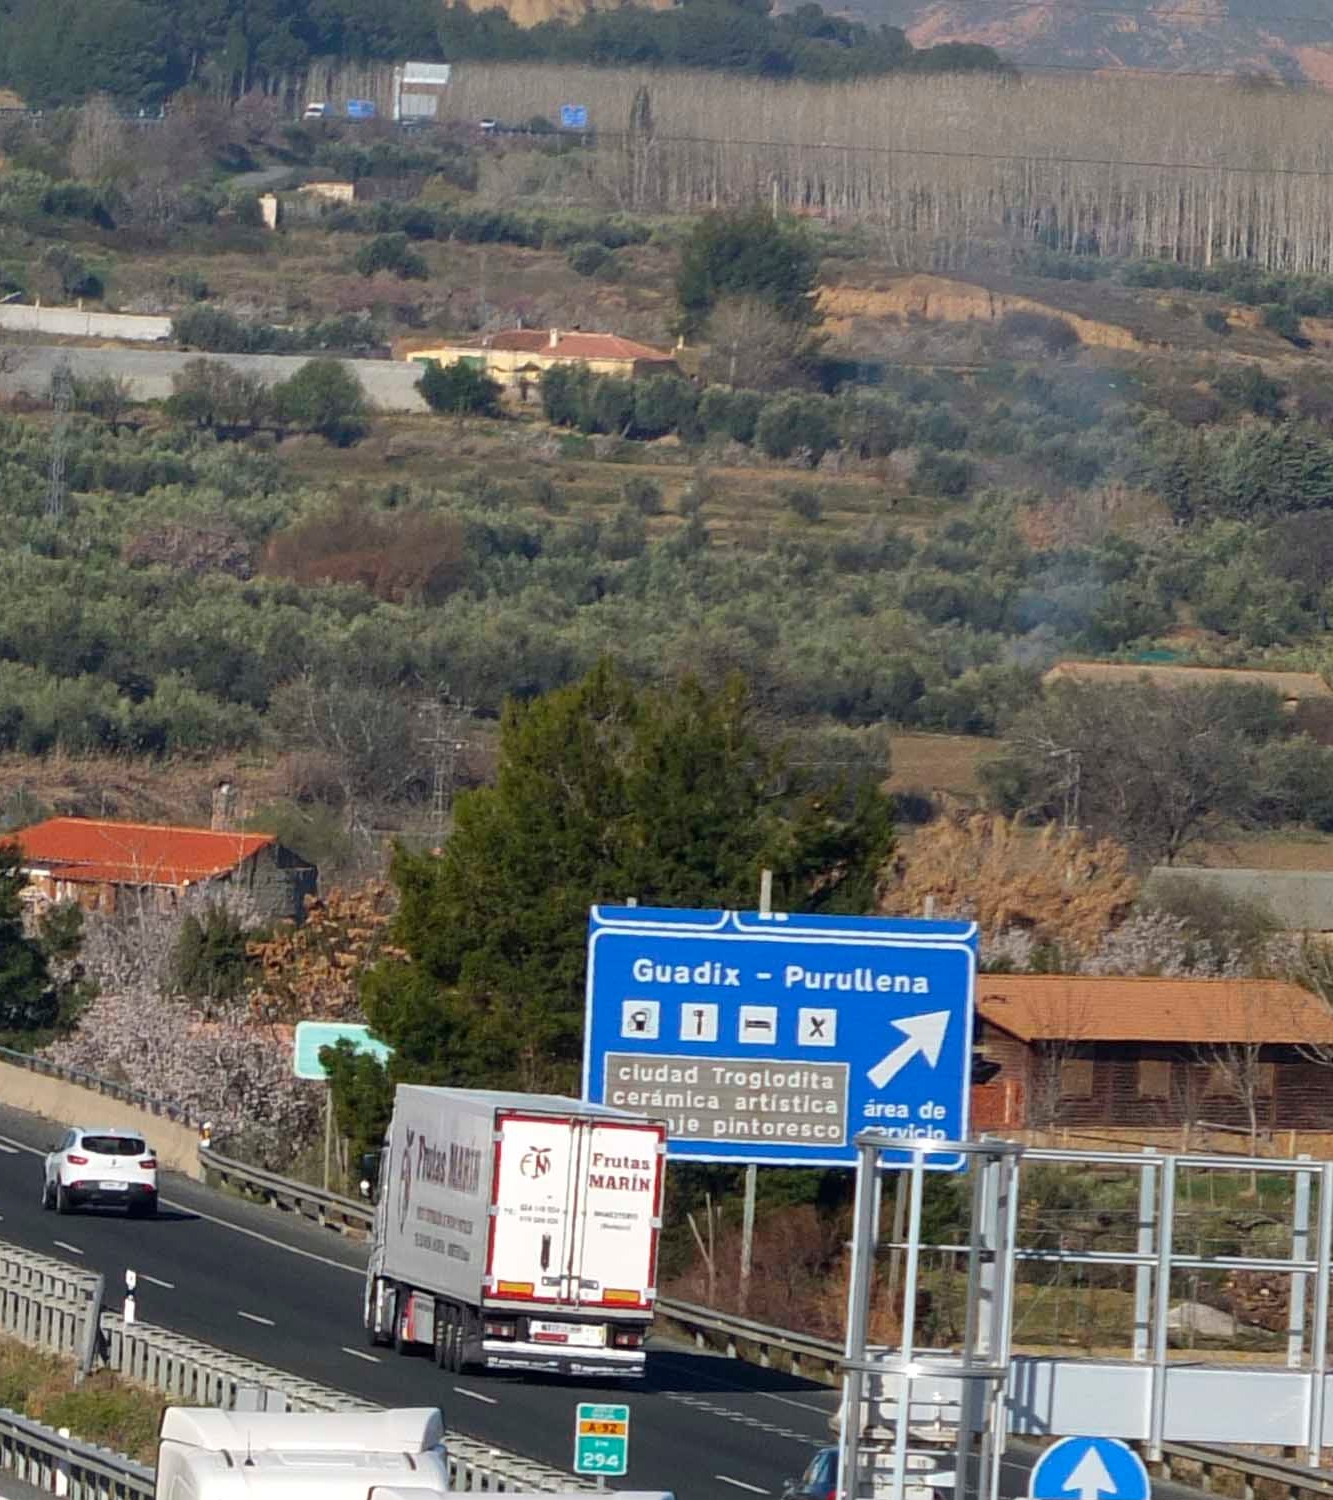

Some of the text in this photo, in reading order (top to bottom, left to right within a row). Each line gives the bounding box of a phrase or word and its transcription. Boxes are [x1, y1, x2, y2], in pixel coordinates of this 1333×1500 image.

[632, 957, 741, 987] Guadix
[785, 965, 929, 995] Purullena
[618, 1065, 834, 1090] ciudad Troglodita
[612, 1088, 839, 1114] cerámica artística
[863, 1099, 947, 1119] área de
[713, 1116, 841, 1139] pintoresco
[591, 1152, 651, 1170] Frutas
[589, 1173, 652, 1192] MARÍN
[588, 1423, 619, 1434] A-92
[582, 1452, 620, 1468] 294
